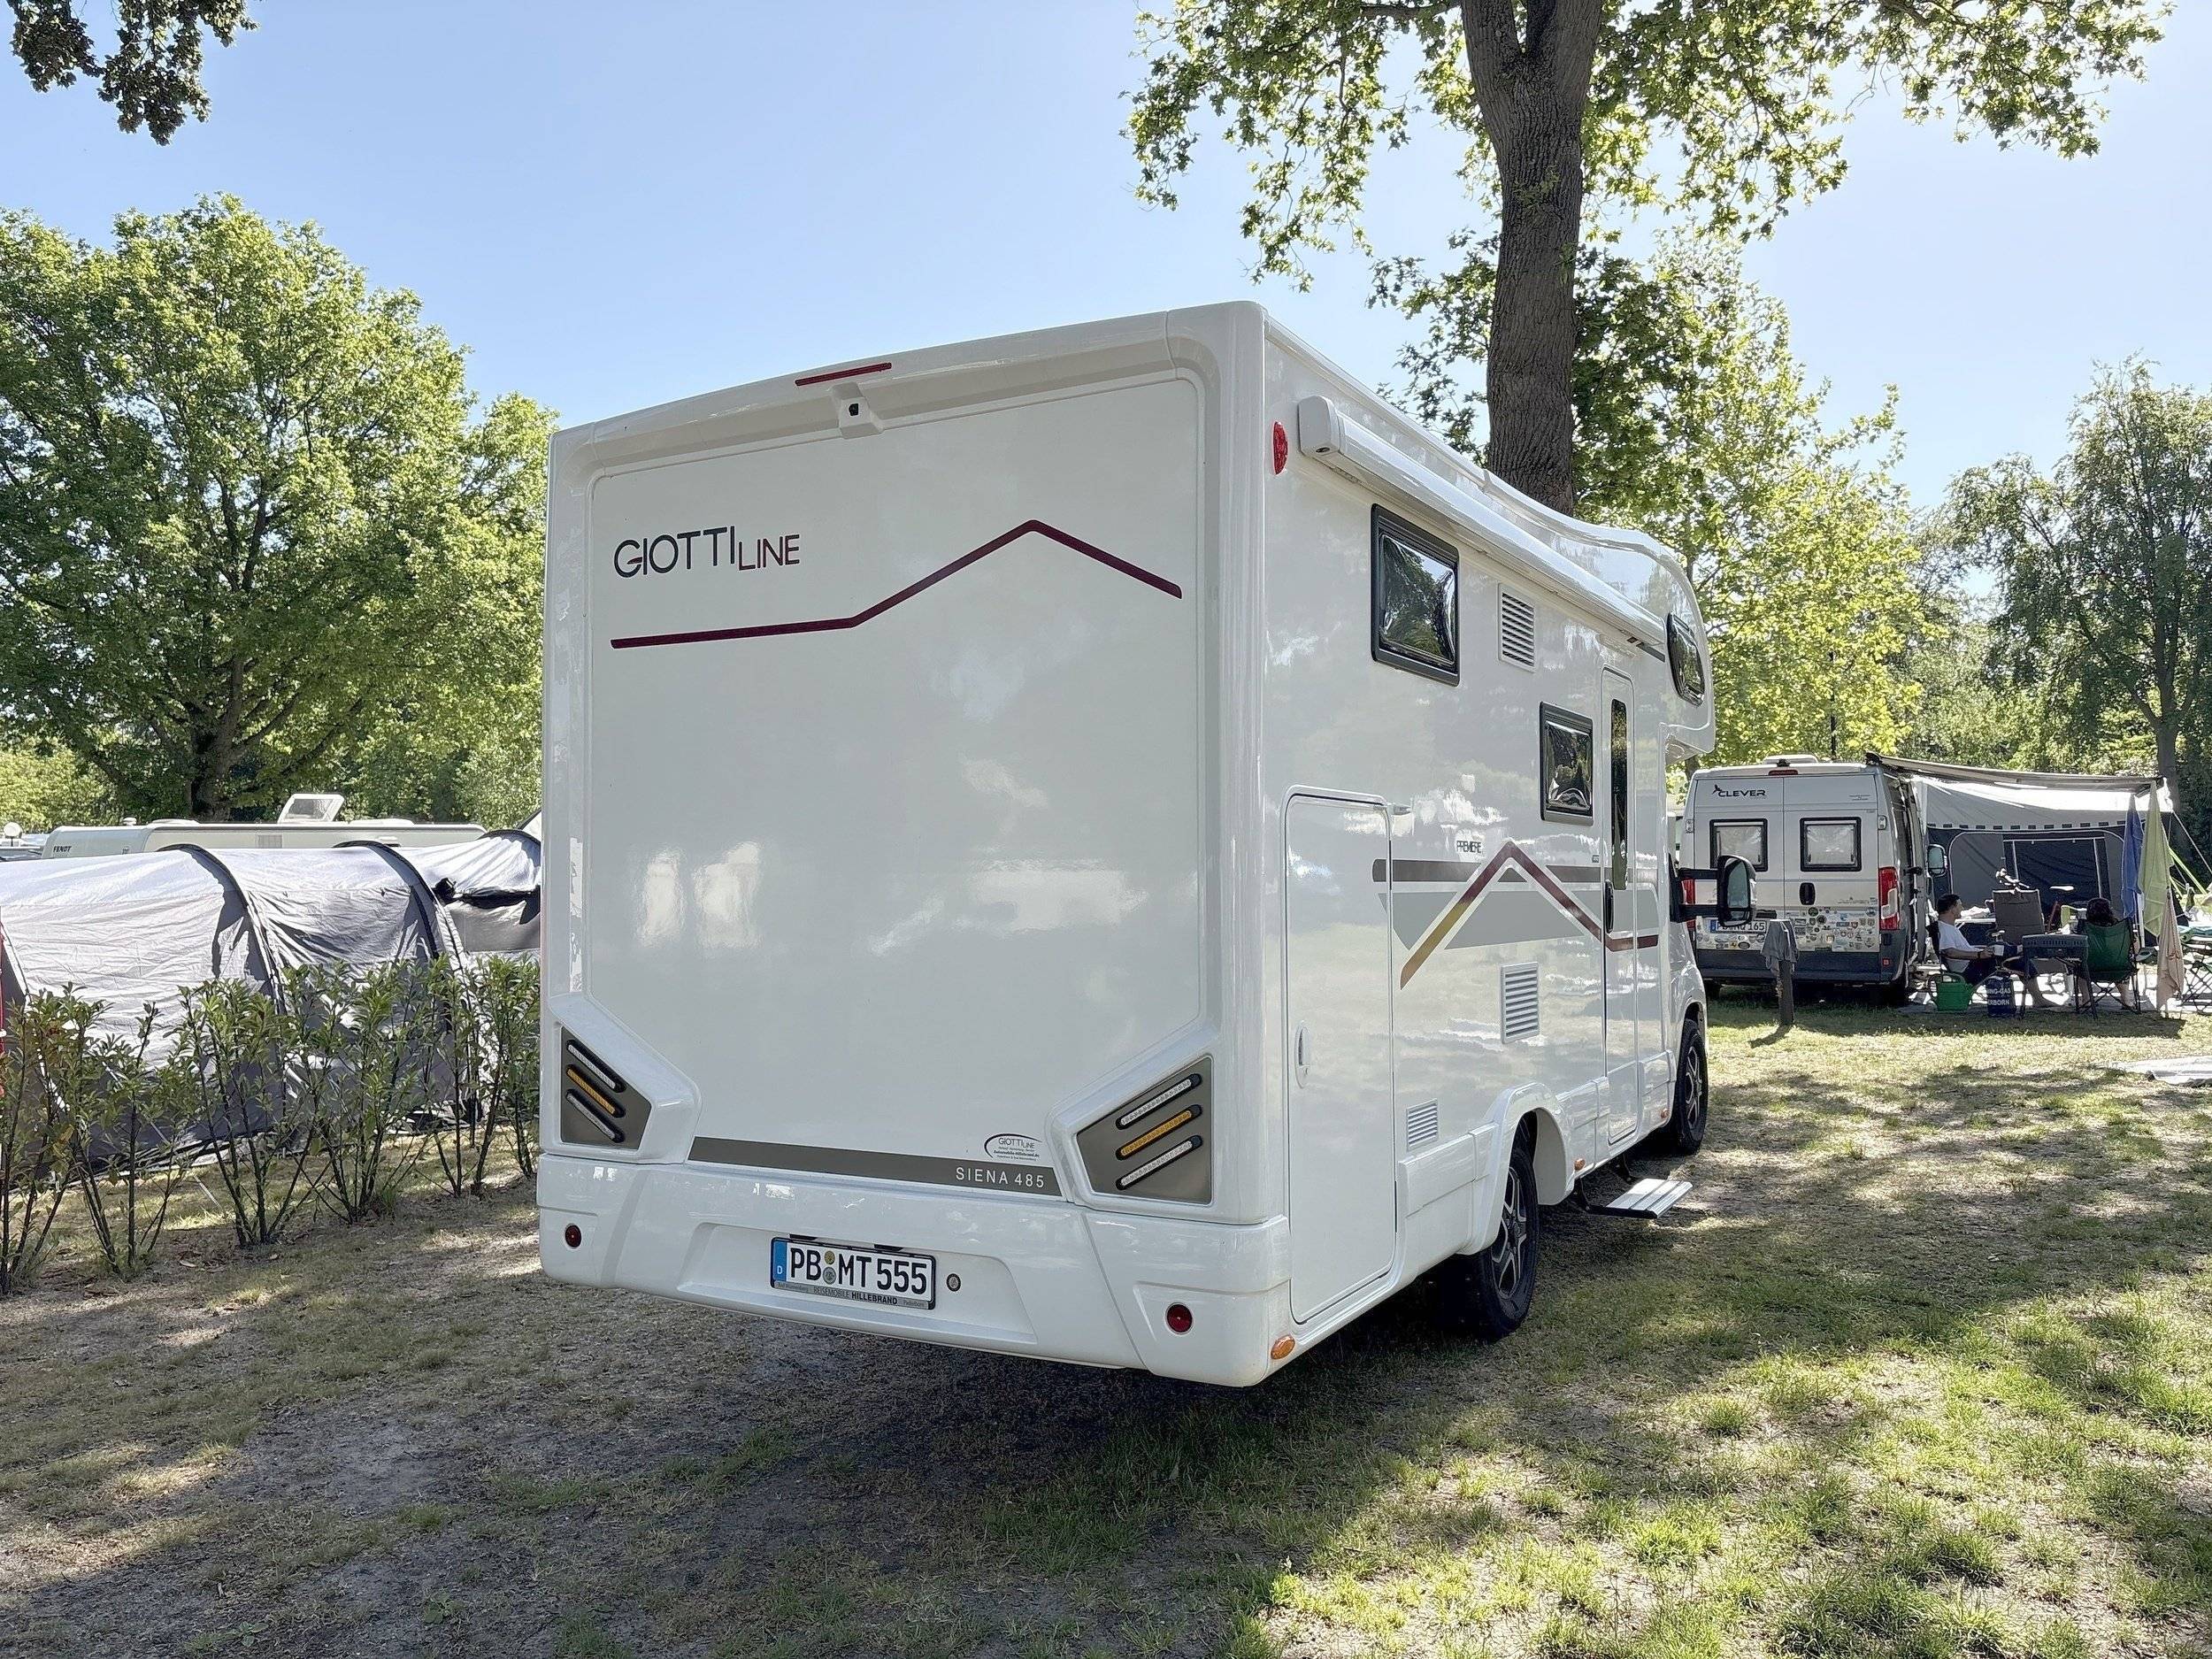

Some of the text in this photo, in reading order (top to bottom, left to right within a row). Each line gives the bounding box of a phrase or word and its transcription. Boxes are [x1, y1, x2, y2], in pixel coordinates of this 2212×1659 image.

[956, 1166, 1045, 1188] SIENA 485
[776, 1265, 783, 1275] D
[790, 1247, 927, 1294] PB MT 555
[851, 1292, 898, 1305] HILLEBRAND
